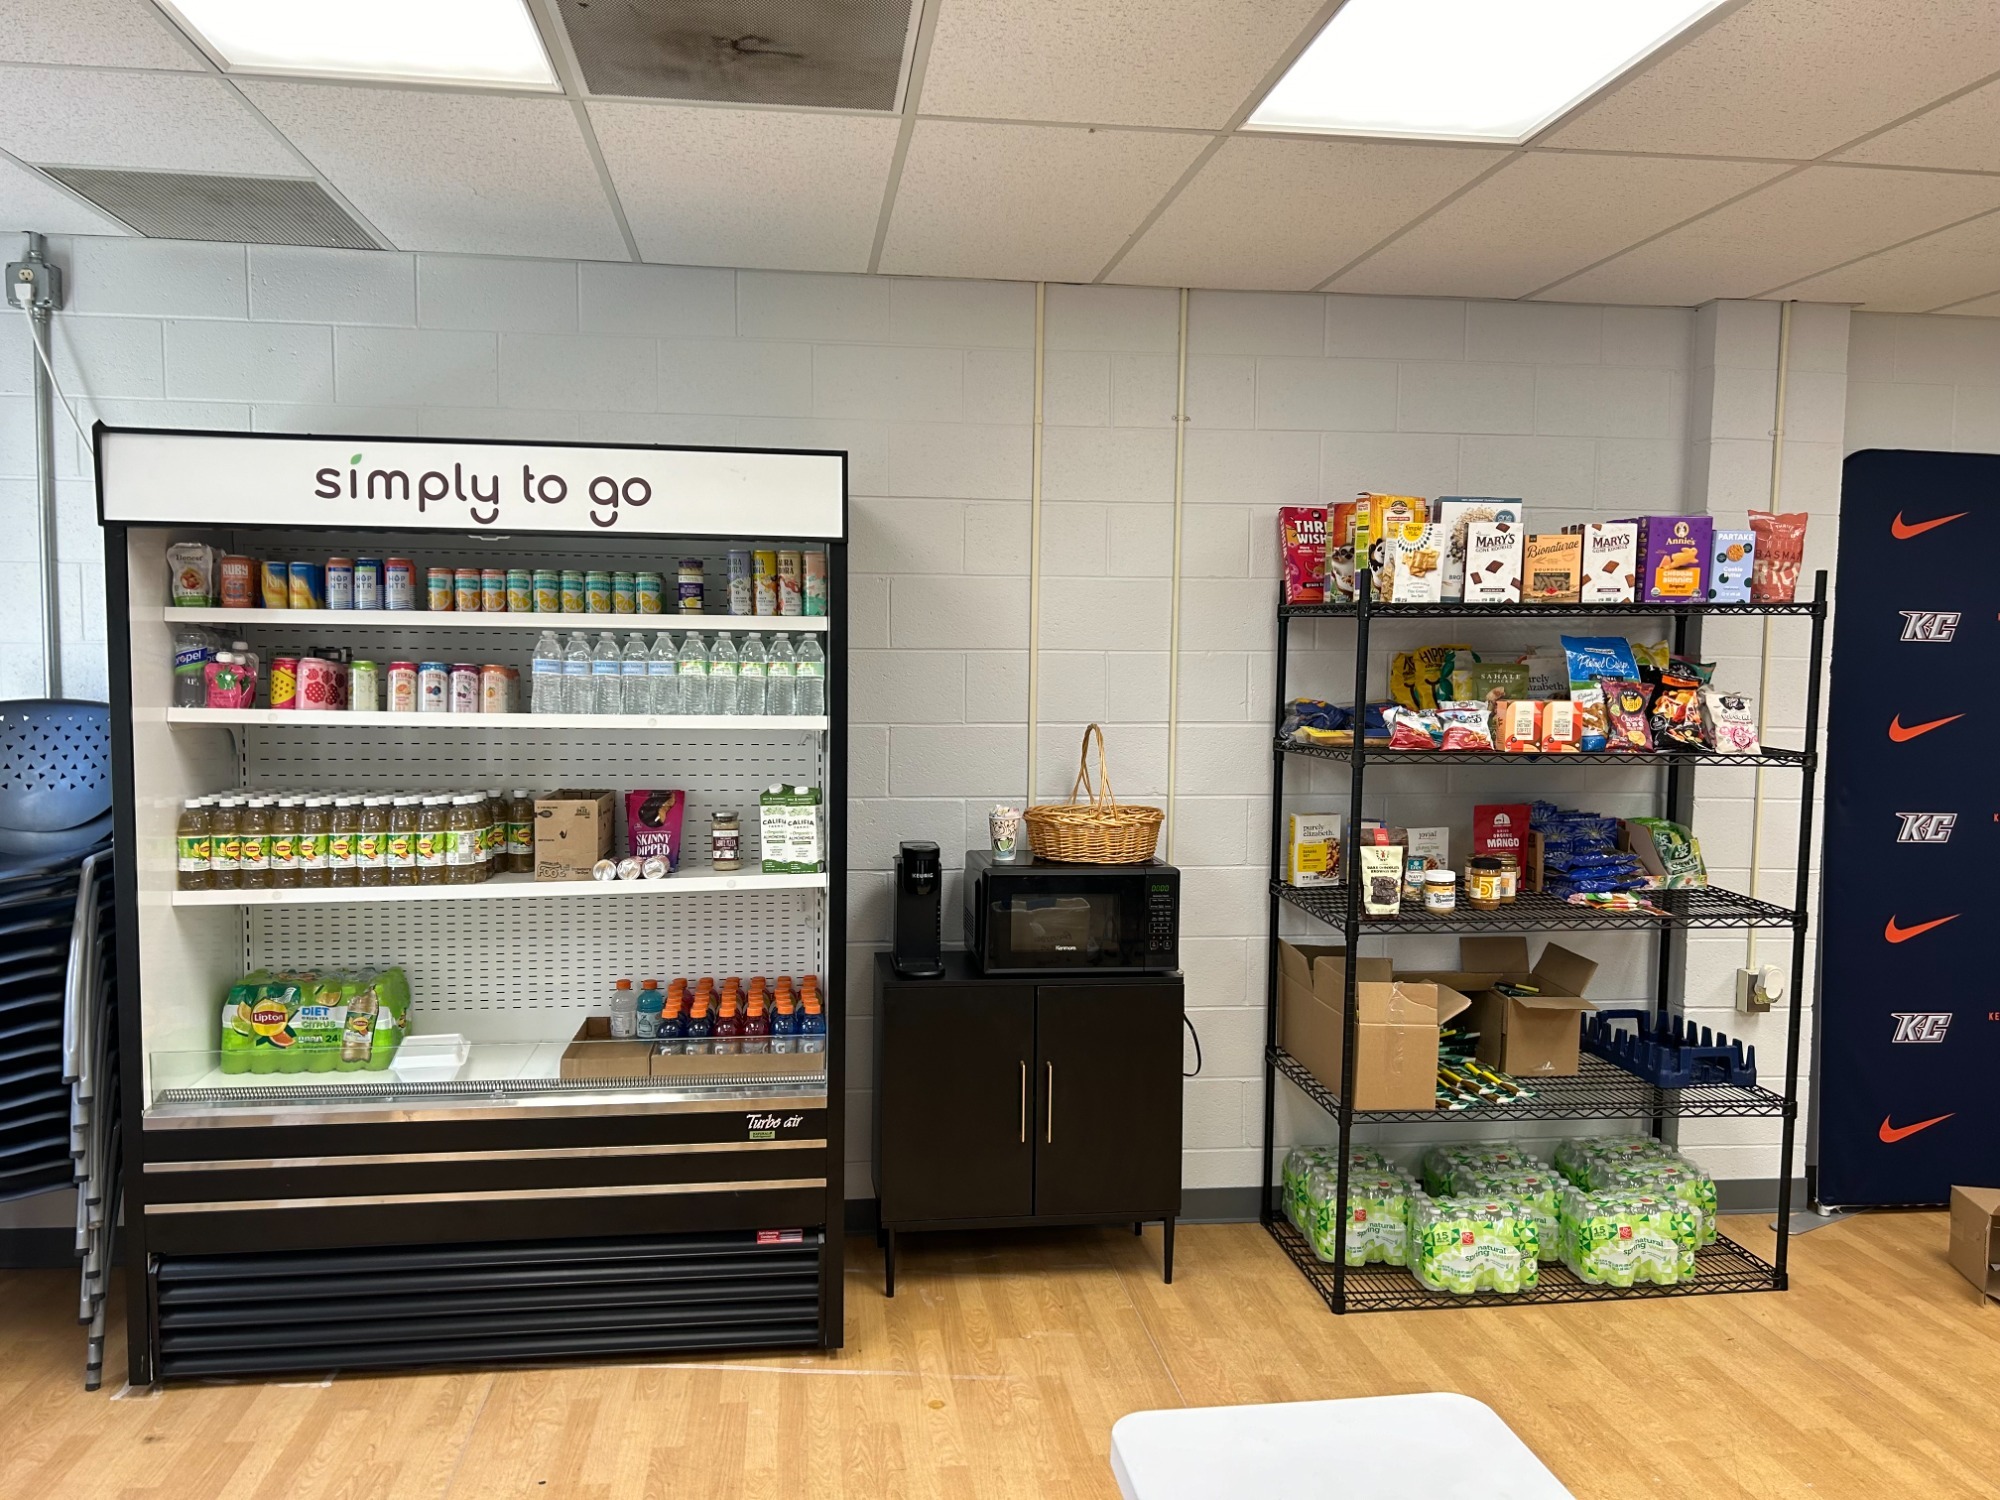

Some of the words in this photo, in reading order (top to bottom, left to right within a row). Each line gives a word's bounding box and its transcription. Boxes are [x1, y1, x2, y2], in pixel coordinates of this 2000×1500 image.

[314, 453, 499, 525] simply
[523, 464, 568, 504] to
[588, 475, 652, 527] go
[1294, 520, 1327, 533] THR
[1476, 533, 1515, 547] MARY'S
[1593, 534, 1630, 547] MARY'S
[222, 564, 248, 576] RUBY
[175, 651, 201, 665] ropel
[787, 819, 815, 827] CALIFIA
[636, 833, 671, 846] SKINNY
[1487, 838, 1520, 848] MANGO
[636, 843, 670, 856] DIPPED
[301, 1007, 329, 1016] DIET
[254, 1013, 283, 1023] Lipton
[301, 1020, 336, 1028] CITRUS
[325, 1034, 338, 1043] 24
[775, 1043, 785, 1054] G
[804, 1043, 814, 1054] G
[746, 1113, 782, 1129] Turbo
[783, 1114, 804, 1128] air
[1369, 1222, 1396, 1230] natural
[1593, 1225, 1605, 1234] 15
[1357, 1227, 1381, 1238] spring
[1436, 1232, 1448, 1240] 15
[1635, 1237, 1664, 1247] natural
[1477, 1245, 1507, 1254] natural
[1623, 1242, 1646, 1256] spring
[1465, 1250, 1490, 1262] spring
